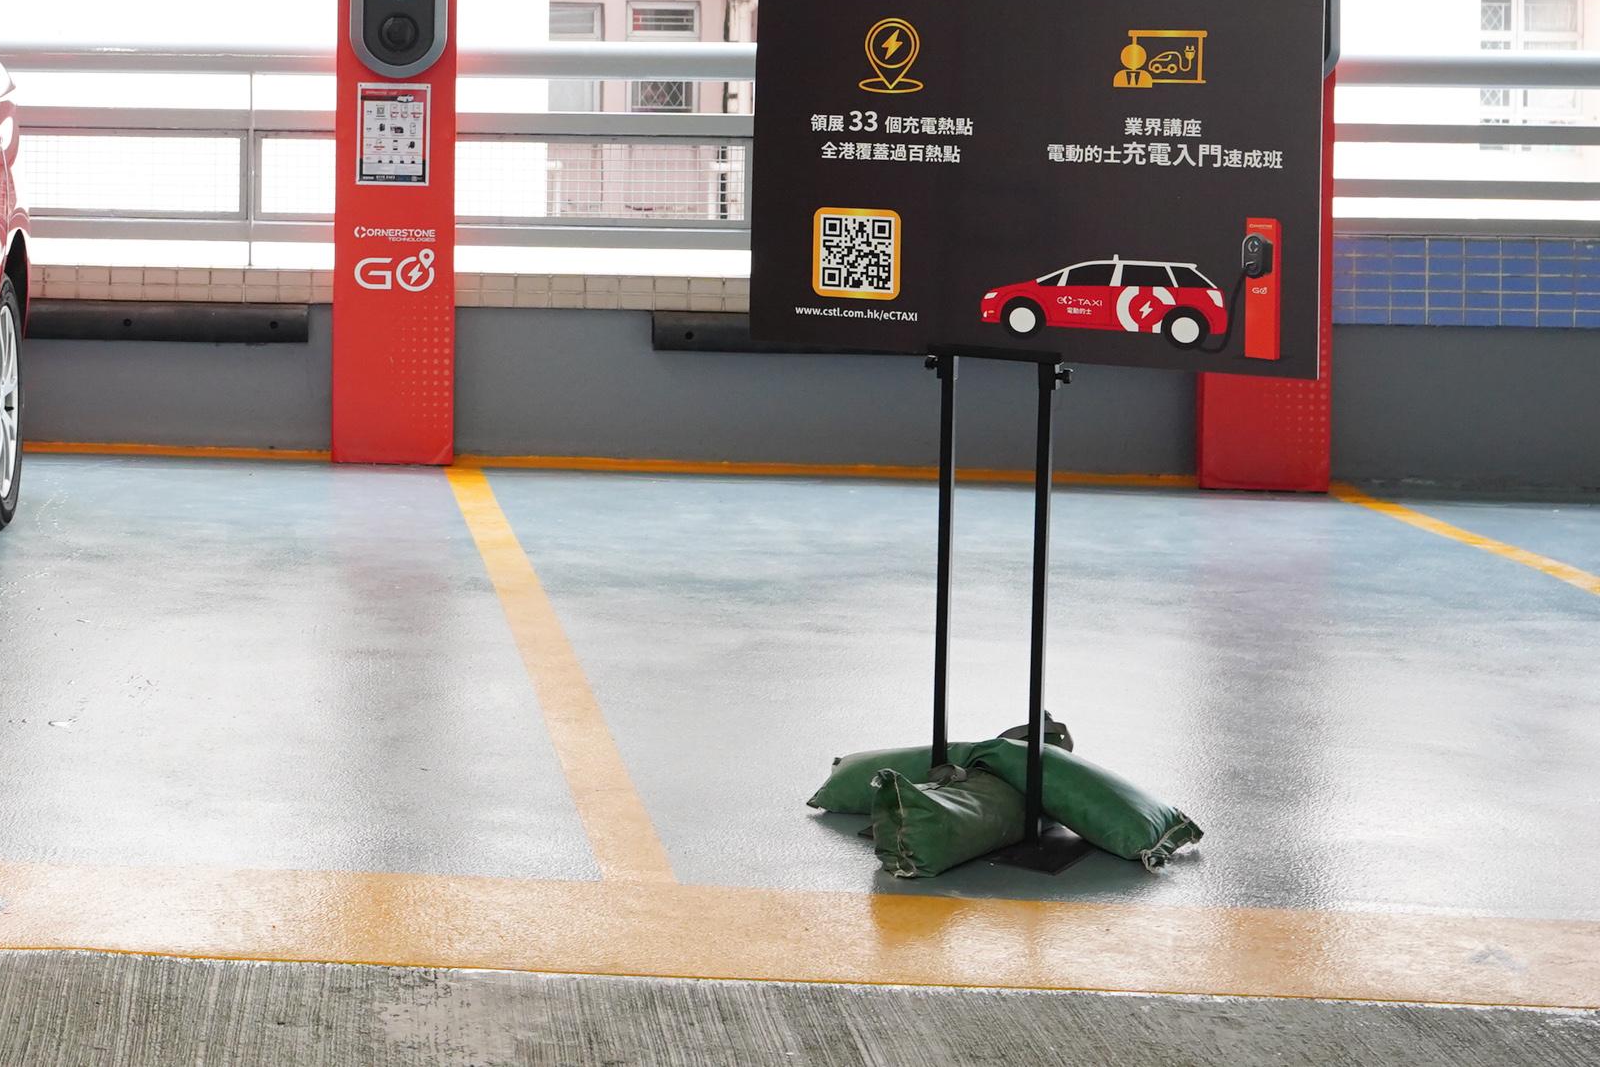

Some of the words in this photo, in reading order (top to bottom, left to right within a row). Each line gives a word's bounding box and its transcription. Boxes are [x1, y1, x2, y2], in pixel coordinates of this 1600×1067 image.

[810, 114, 844, 132] 領展
[849, 110, 878, 132] 33
[885, 116, 973, 135] 個充電熱點
[1124, 117, 1201, 137] 業界講座
[821, 141, 961, 163] 全港覆蓋過百熱點
[1047, 142, 1283, 169] 電動的士充電入門速成班
[354, 226, 436, 238] CORNERSTONE
[354, 248, 435, 292] GO
[795, 305, 918, 322] www.cstl.com.hk/eCTAXI
